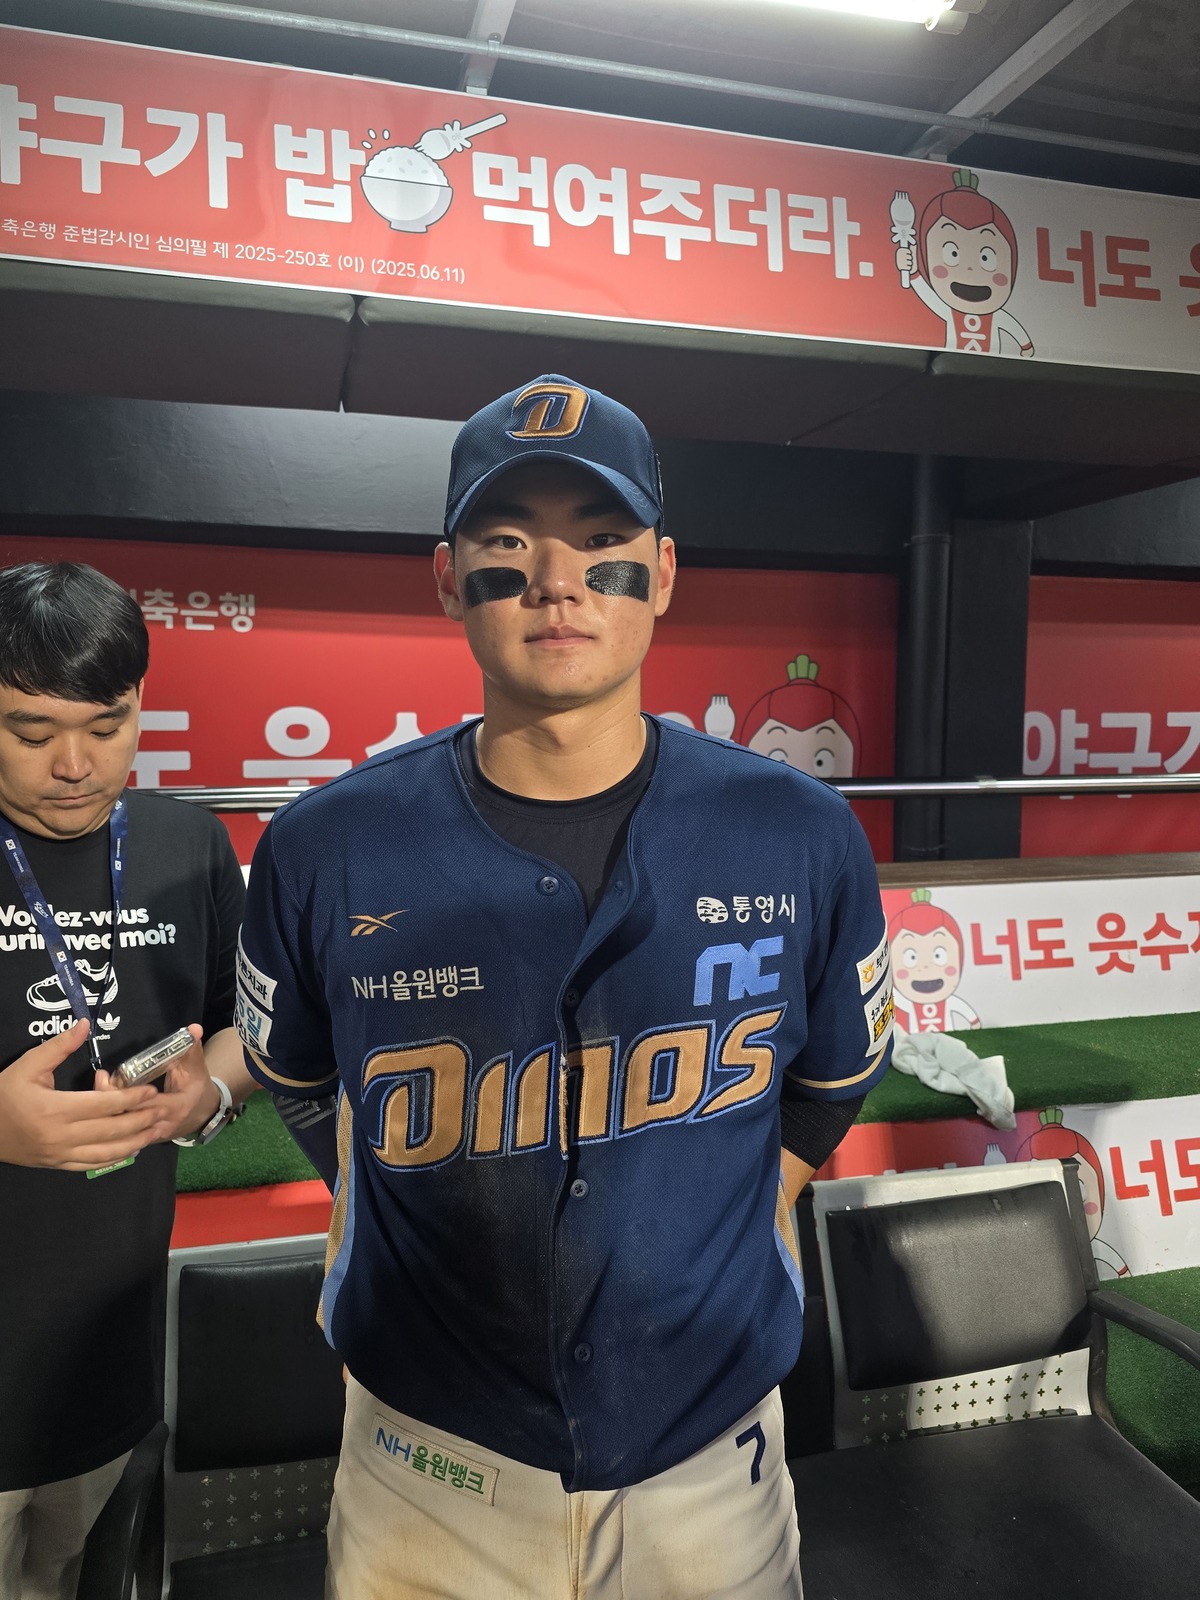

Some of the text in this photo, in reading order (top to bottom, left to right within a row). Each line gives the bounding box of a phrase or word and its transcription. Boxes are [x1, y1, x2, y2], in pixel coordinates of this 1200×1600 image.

[273, 123, 366, 223] 밥
[472, 150, 874, 280] 먹여주더라.
[1, 218, 466, 285] 축은행 준법감시인 심의필 제 2025-250호 (이) (2025.06.11)
[1036, 227, 1161, 307] 너도
[505, 383, 590, 441] D
[131, 588, 256, 633] 축은행
[119, 923, 177, 948] moi?
[732, 894, 796, 924] 통영시
[970, 917, 1075, 981] 너도
[351, 965, 485, 1001] NH올원뱅크
[28, 1014, 79, 1036] adid
[375, 1426, 485, 1495] NH올원뱅크
[735, 1421, 766, 1486] 7
